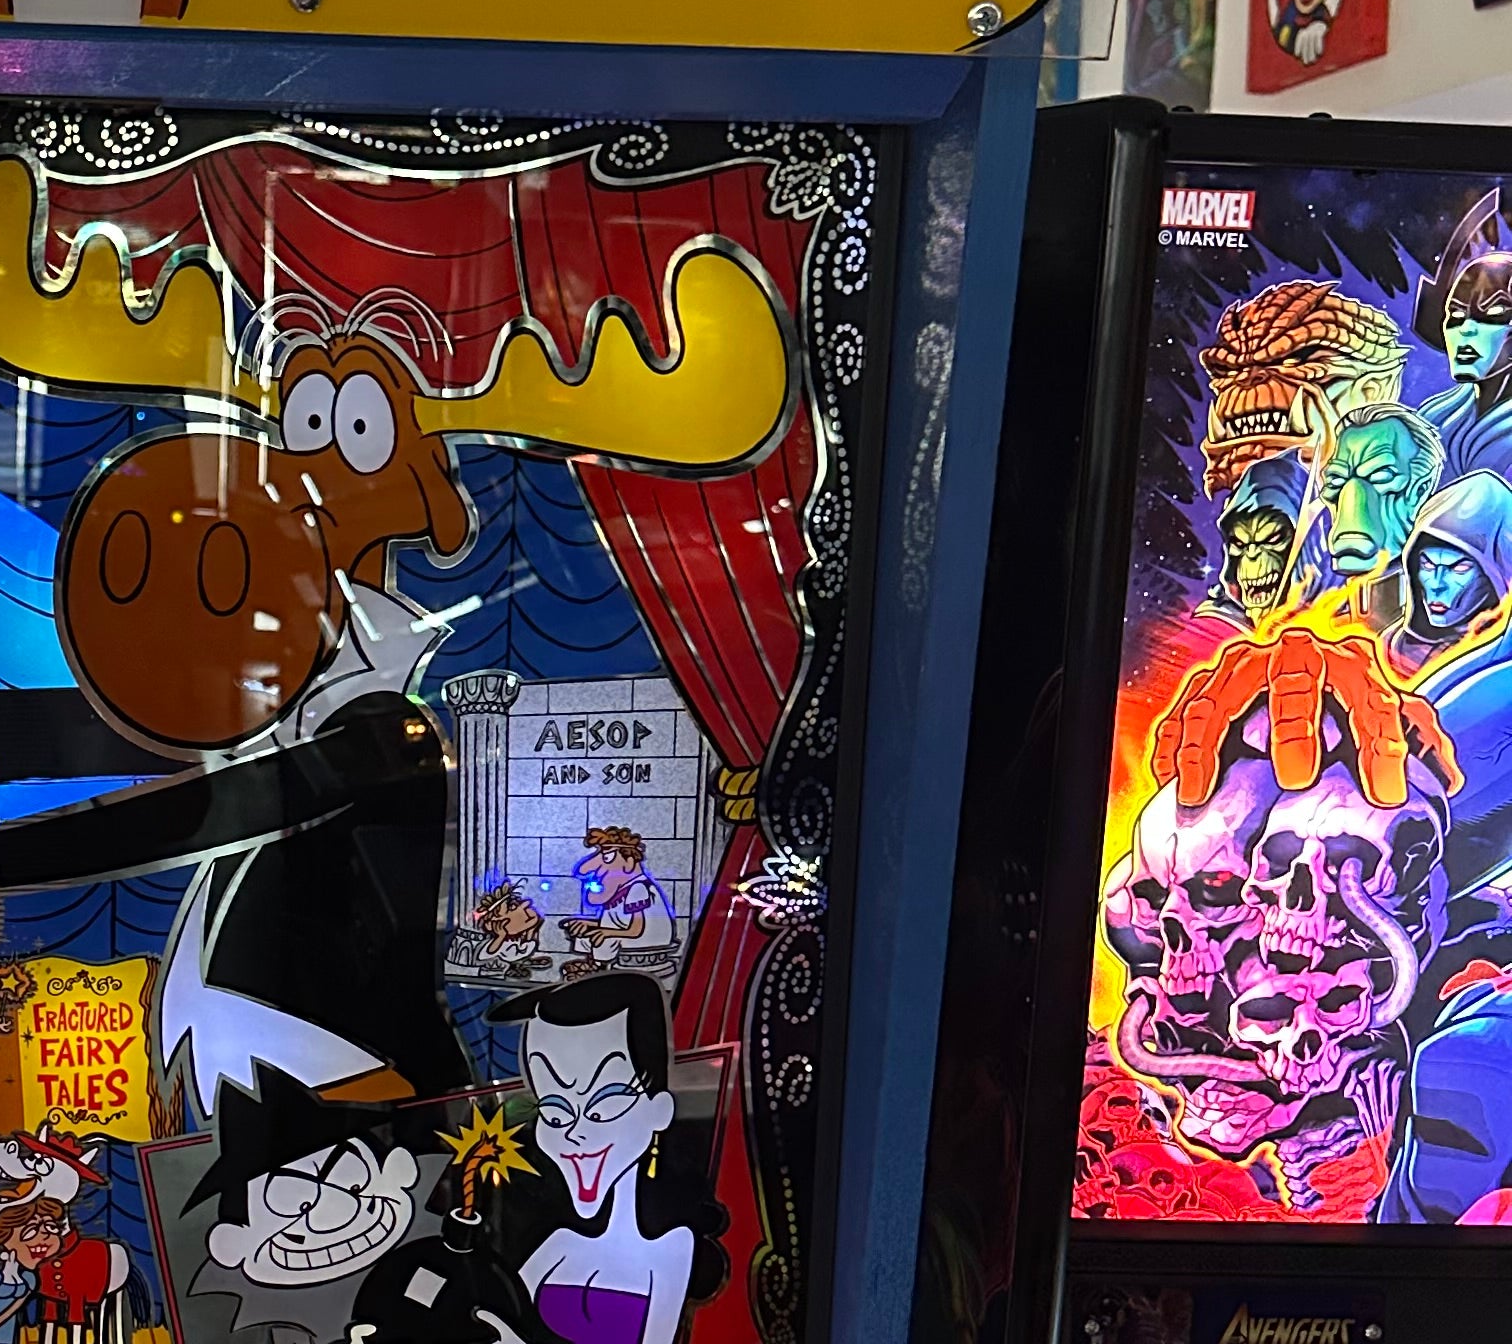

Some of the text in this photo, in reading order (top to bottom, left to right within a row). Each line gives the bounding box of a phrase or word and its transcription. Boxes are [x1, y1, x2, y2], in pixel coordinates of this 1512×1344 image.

[1160, 189, 1253, 228] MARVEL
[1175, 230, 1249, 248] MARVEL
[533, 719, 653, 752] AESOP
[543, 763, 652, 785] AND SON
[33, 1001, 134, 1033] FRACTURED
[37, 1069, 129, 1111] TALES
